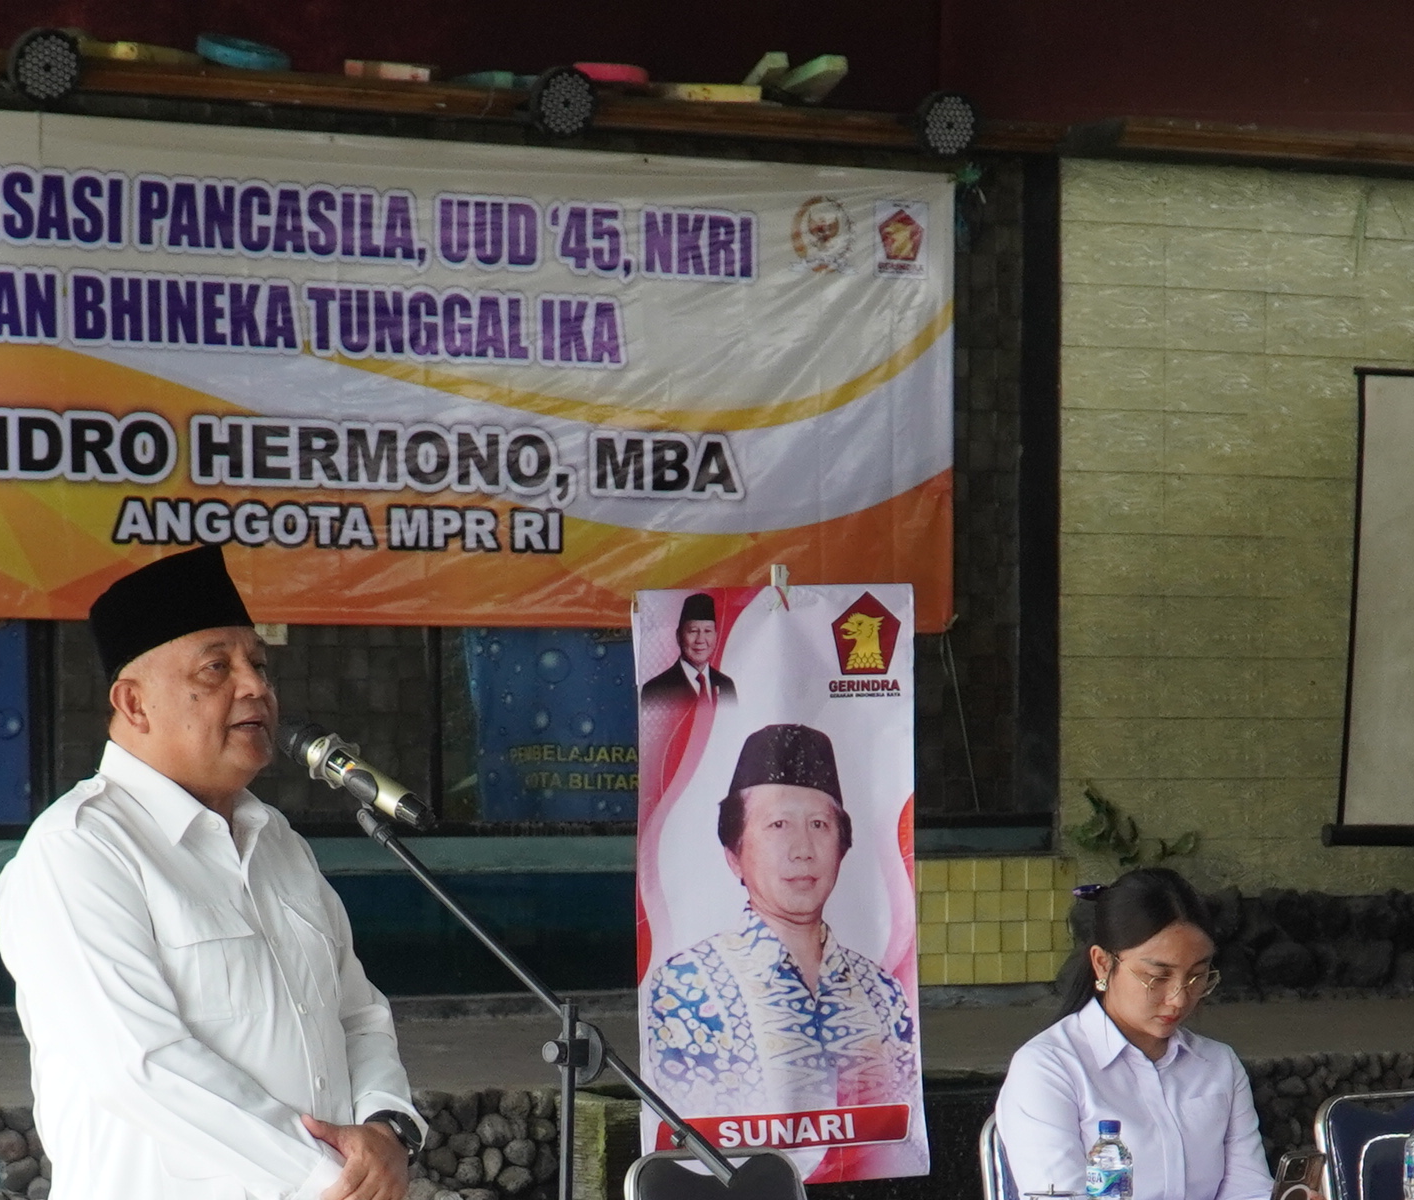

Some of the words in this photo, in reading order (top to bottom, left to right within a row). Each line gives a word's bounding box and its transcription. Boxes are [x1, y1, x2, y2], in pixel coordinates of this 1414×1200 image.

[138, 180, 426, 268] PANCASILA,
[439, 197, 538, 267] UUD
[643, 210, 755, 279] NKRI
[72, 275, 299, 350] BHINEKA
[306, 289, 530, 359] TUNGGAL
[542, 298, 623, 365] IKA
[195, 419, 571, 502] HERMONO,
[595, 433, 739, 495] MBA
[116, 500, 372, 546] ANGGOTA
[391, 508, 497, 550] MPR
[513, 509, 563, 552] RI
[829, 678, 900, 692] GERINDRA
[509, 744, 639, 763] PEMBELAJARA
[717, 1110, 856, 1149] SUNARI
